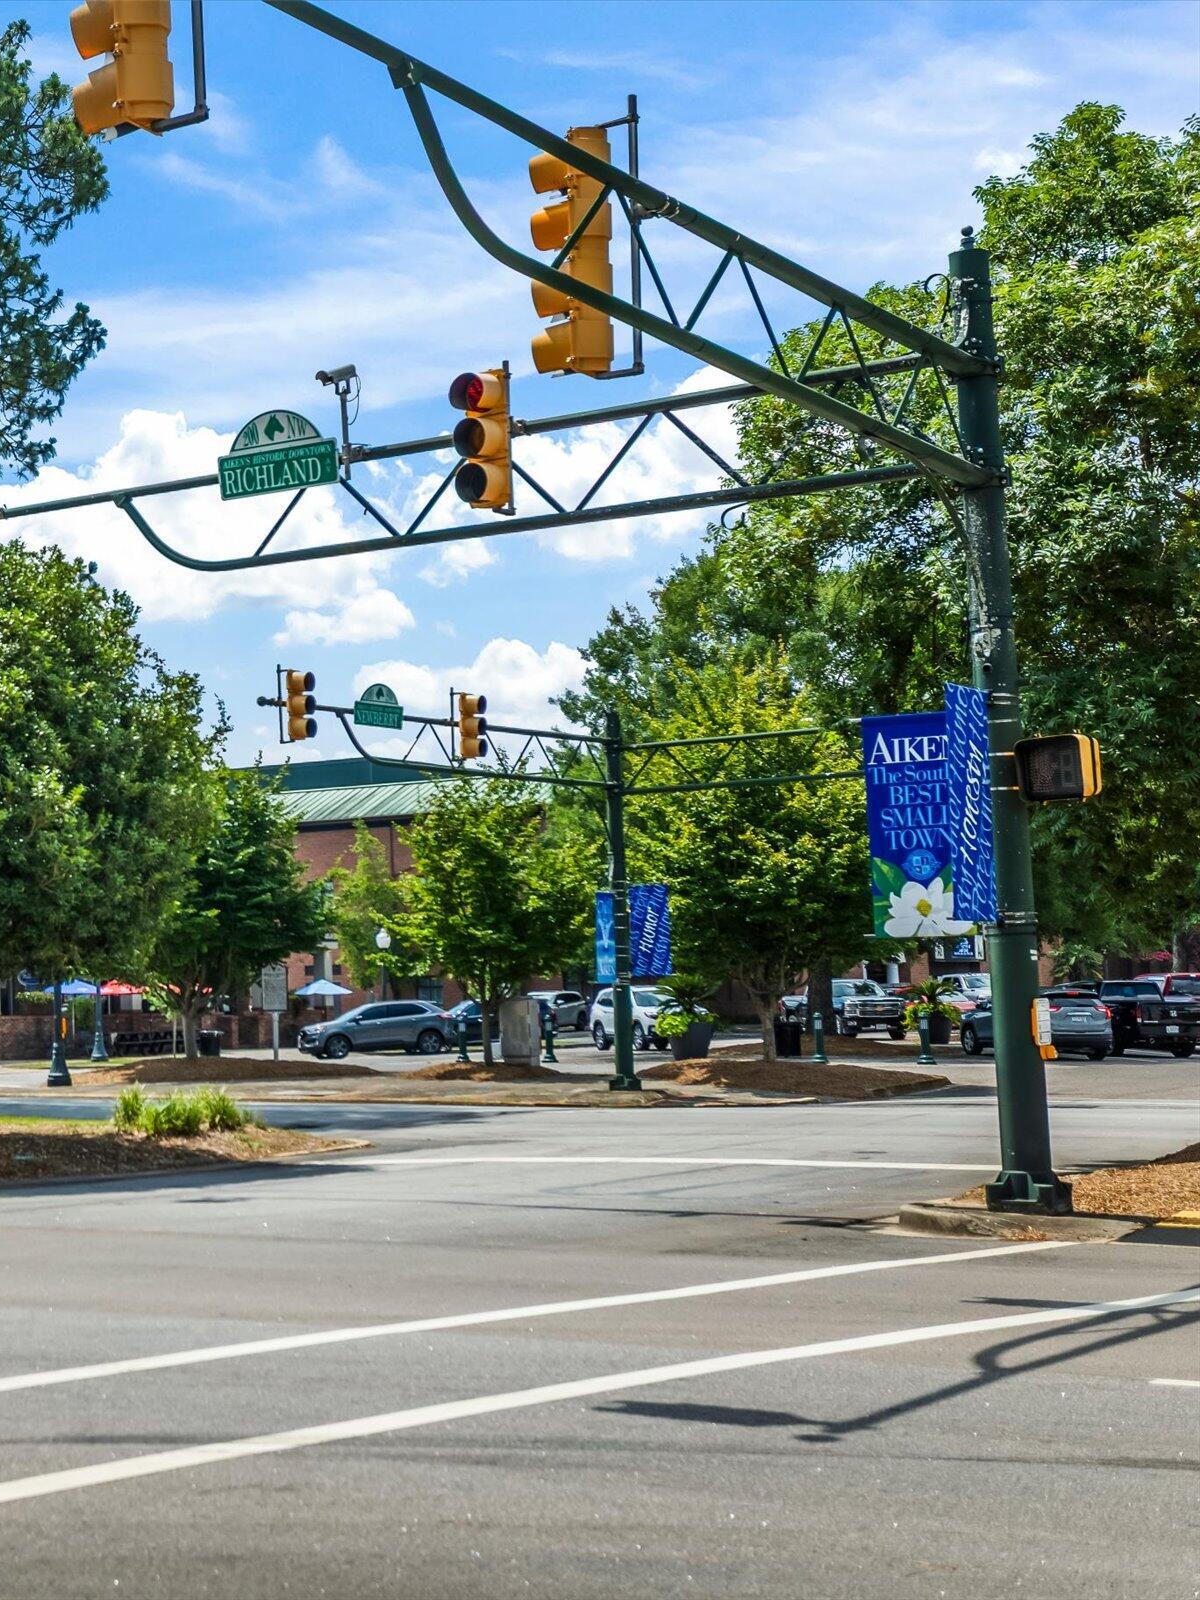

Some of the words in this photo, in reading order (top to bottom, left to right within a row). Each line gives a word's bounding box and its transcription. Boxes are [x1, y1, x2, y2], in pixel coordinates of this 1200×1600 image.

[243, 421, 259, 447] 200
[286, 414, 308, 439] NW
[288, 443, 332, 458] DOWNTOWN
[223, 457, 322, 495] RICHLAND
[868, 766, 902, 785] The
[889, 782, 947, 806] BEST
[960, 740, 984, 866] Honesty
[639, 906, 660, 954] Humor
